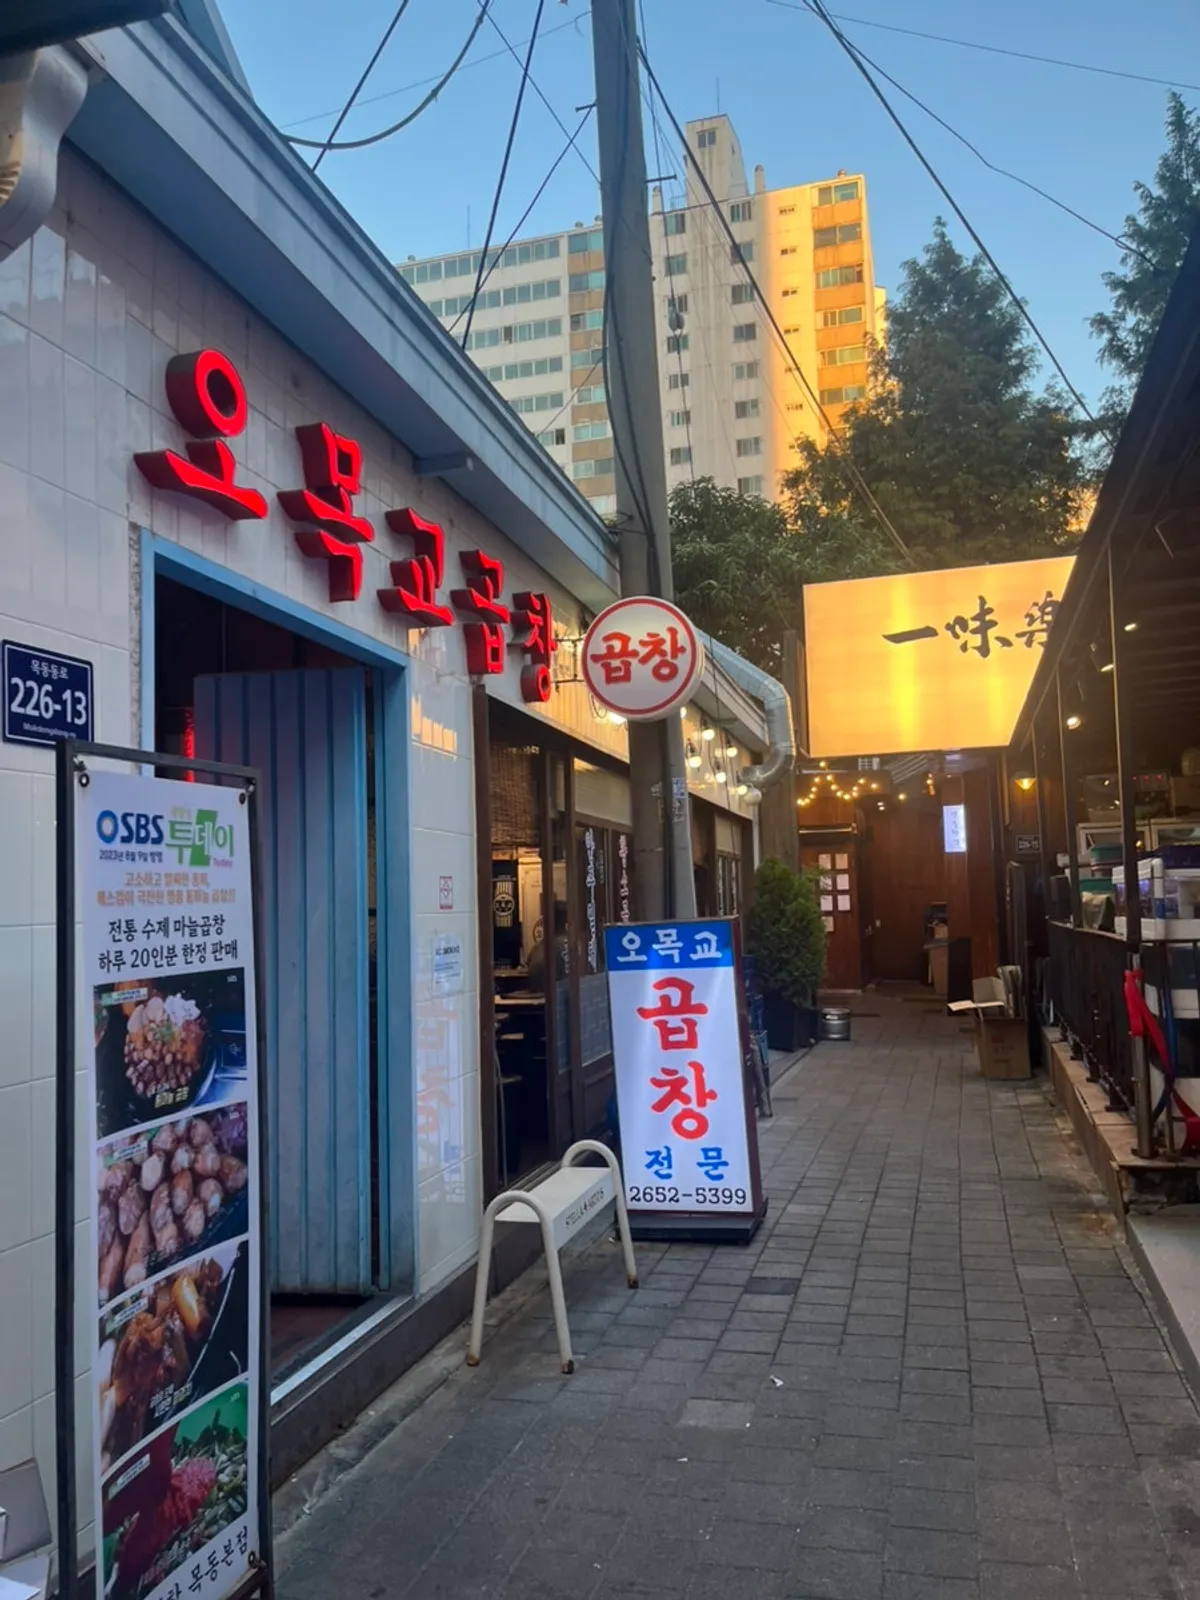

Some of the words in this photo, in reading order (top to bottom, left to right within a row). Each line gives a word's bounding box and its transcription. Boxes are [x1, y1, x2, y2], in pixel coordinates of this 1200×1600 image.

[31, 660, 69, 679] 목동동로
[590, 626, 687, 685] 곱창
[11, 677, 87, 725] 226-13
[165, 820, 234, 866] 투데이
[109, 919, 137, 943] 전통
[142, 916, 170, 939] 수제
[174, 914, 225, 937] 마늘곱창
[98, 950, 126, 973] 하루
[130, 945, 178, 968] 20인분
[182, 942, 207, 964] 한정
[211, 939, 238, 962] 판매
[629, 1186, 747, 1205] 2652-5399
[188, 1525, 249, 1592] 목동본점
